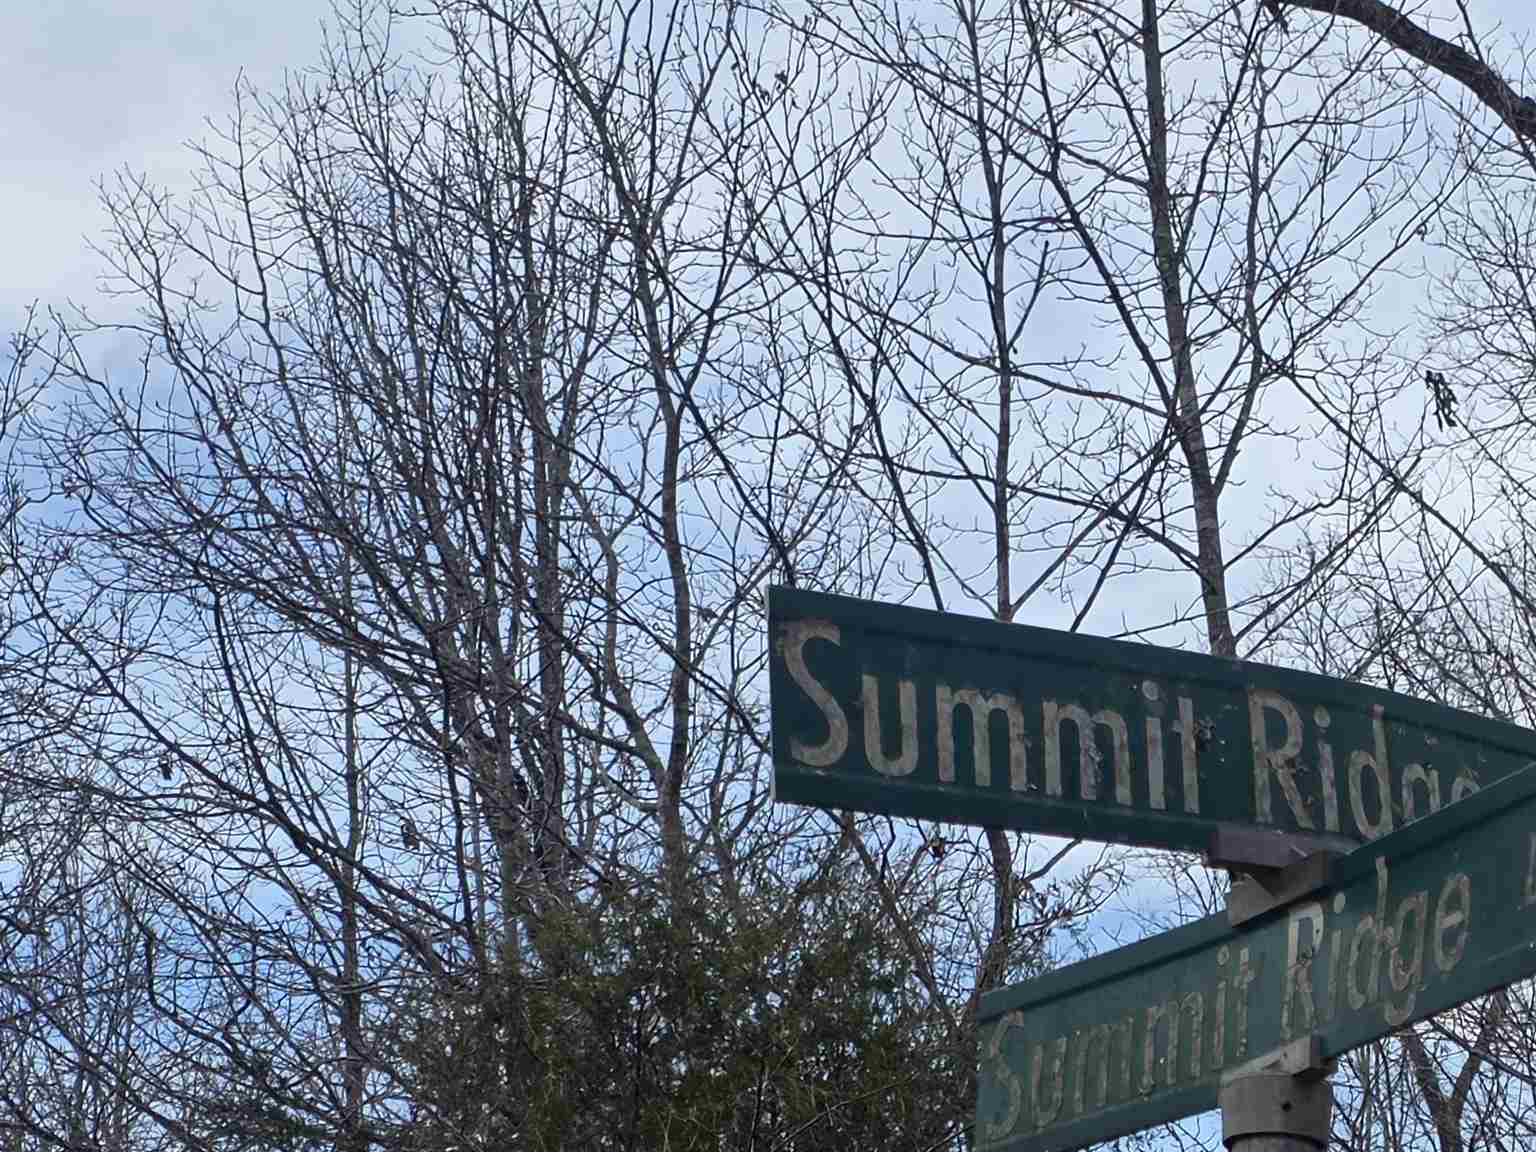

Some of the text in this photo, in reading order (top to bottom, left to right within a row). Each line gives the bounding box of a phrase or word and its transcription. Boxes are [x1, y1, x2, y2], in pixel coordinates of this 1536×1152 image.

[784, 619, 1481, 841] Summit Rid
[984, 946, 1254, 1139] Summit
[1282, 856, 1472, 1038] Ridge
